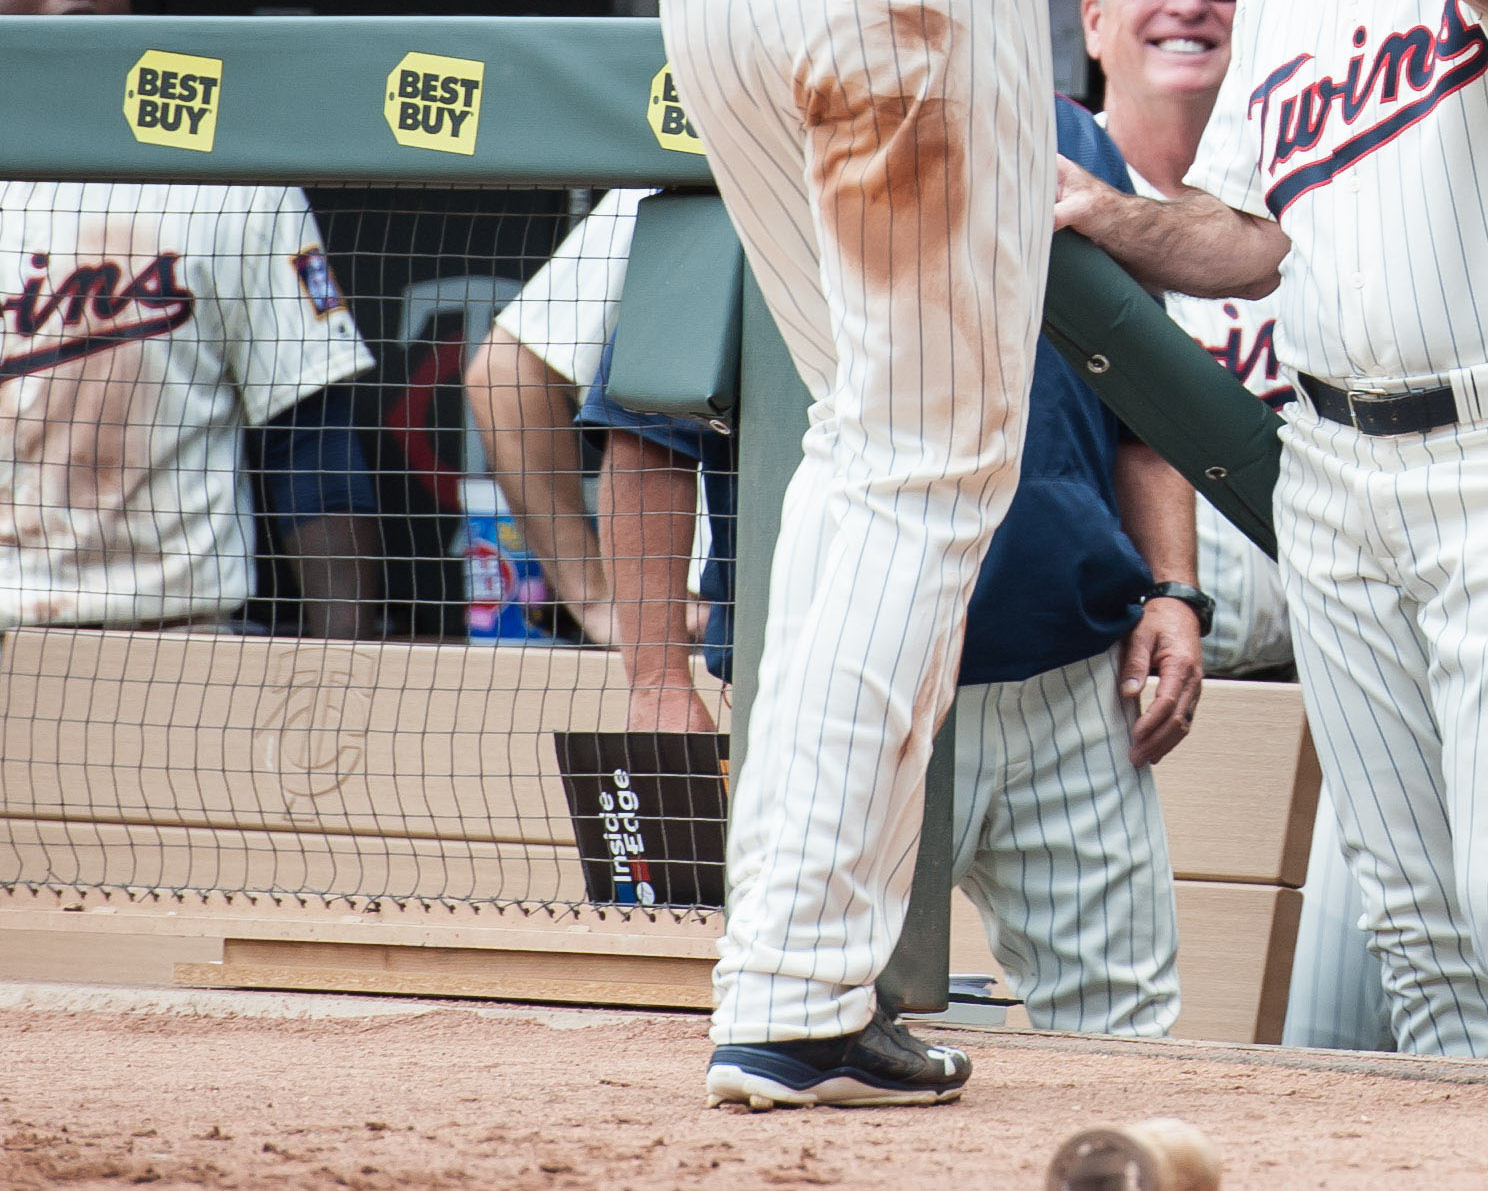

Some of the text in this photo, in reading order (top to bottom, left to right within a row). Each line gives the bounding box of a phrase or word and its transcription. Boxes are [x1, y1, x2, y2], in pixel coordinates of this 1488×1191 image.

[137, 67, 218, 105] BEST
[398, 70, 479, 107] BEST
[137, 98, 208, 135] BUY
[398, 102, 471, 138] BUY
[0, 251, 195, 341] ins
[613, 768, 645, 855] Edge
[599, 791, 633, 882] Inside
